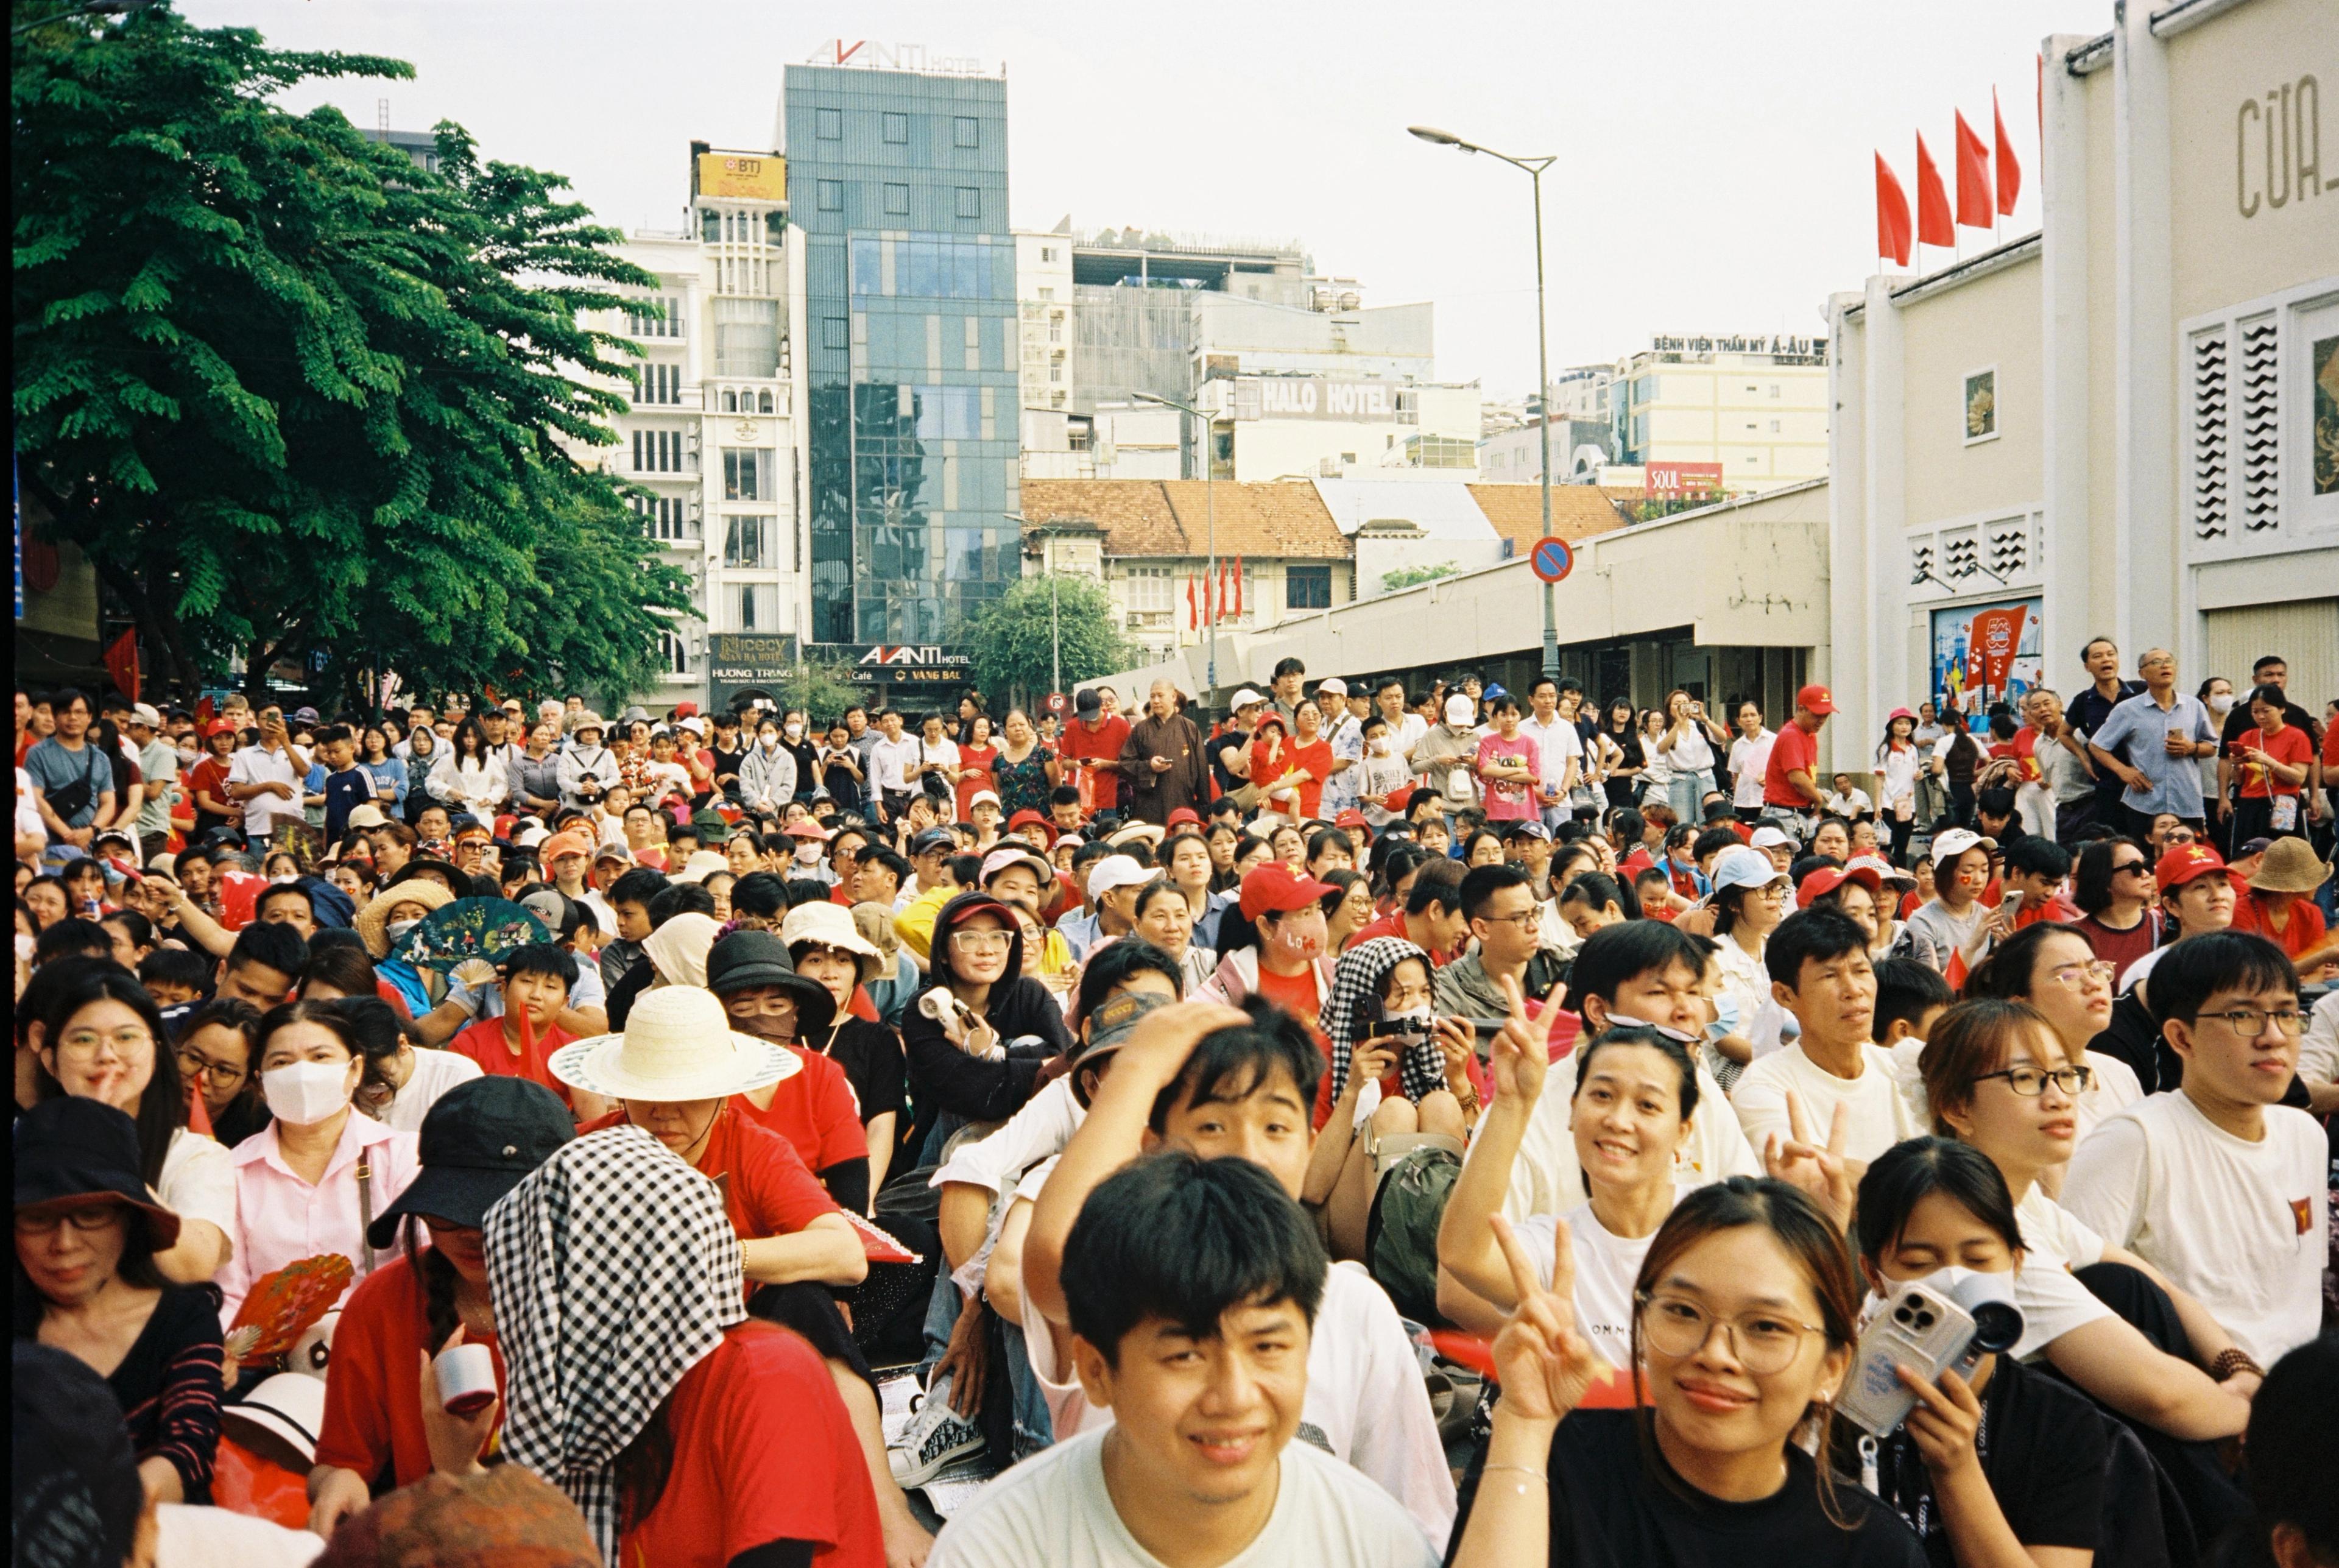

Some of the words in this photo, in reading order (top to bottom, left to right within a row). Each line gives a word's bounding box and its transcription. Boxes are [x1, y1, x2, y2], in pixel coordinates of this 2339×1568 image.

[805, 38, 926, 69] AVANTI
[931, 55, 986, 73] HOTEL
[739, 159, 761, 174] BTJ
[1654, 334, 1684, 351] BỆNH
[1263, 381, 1317, 413] HALO
[1327, 383, 1392, 415] HOTEL
[1652, 470, 1679, 489] SOUL
[859, 646, 940, 664] AVANTI
